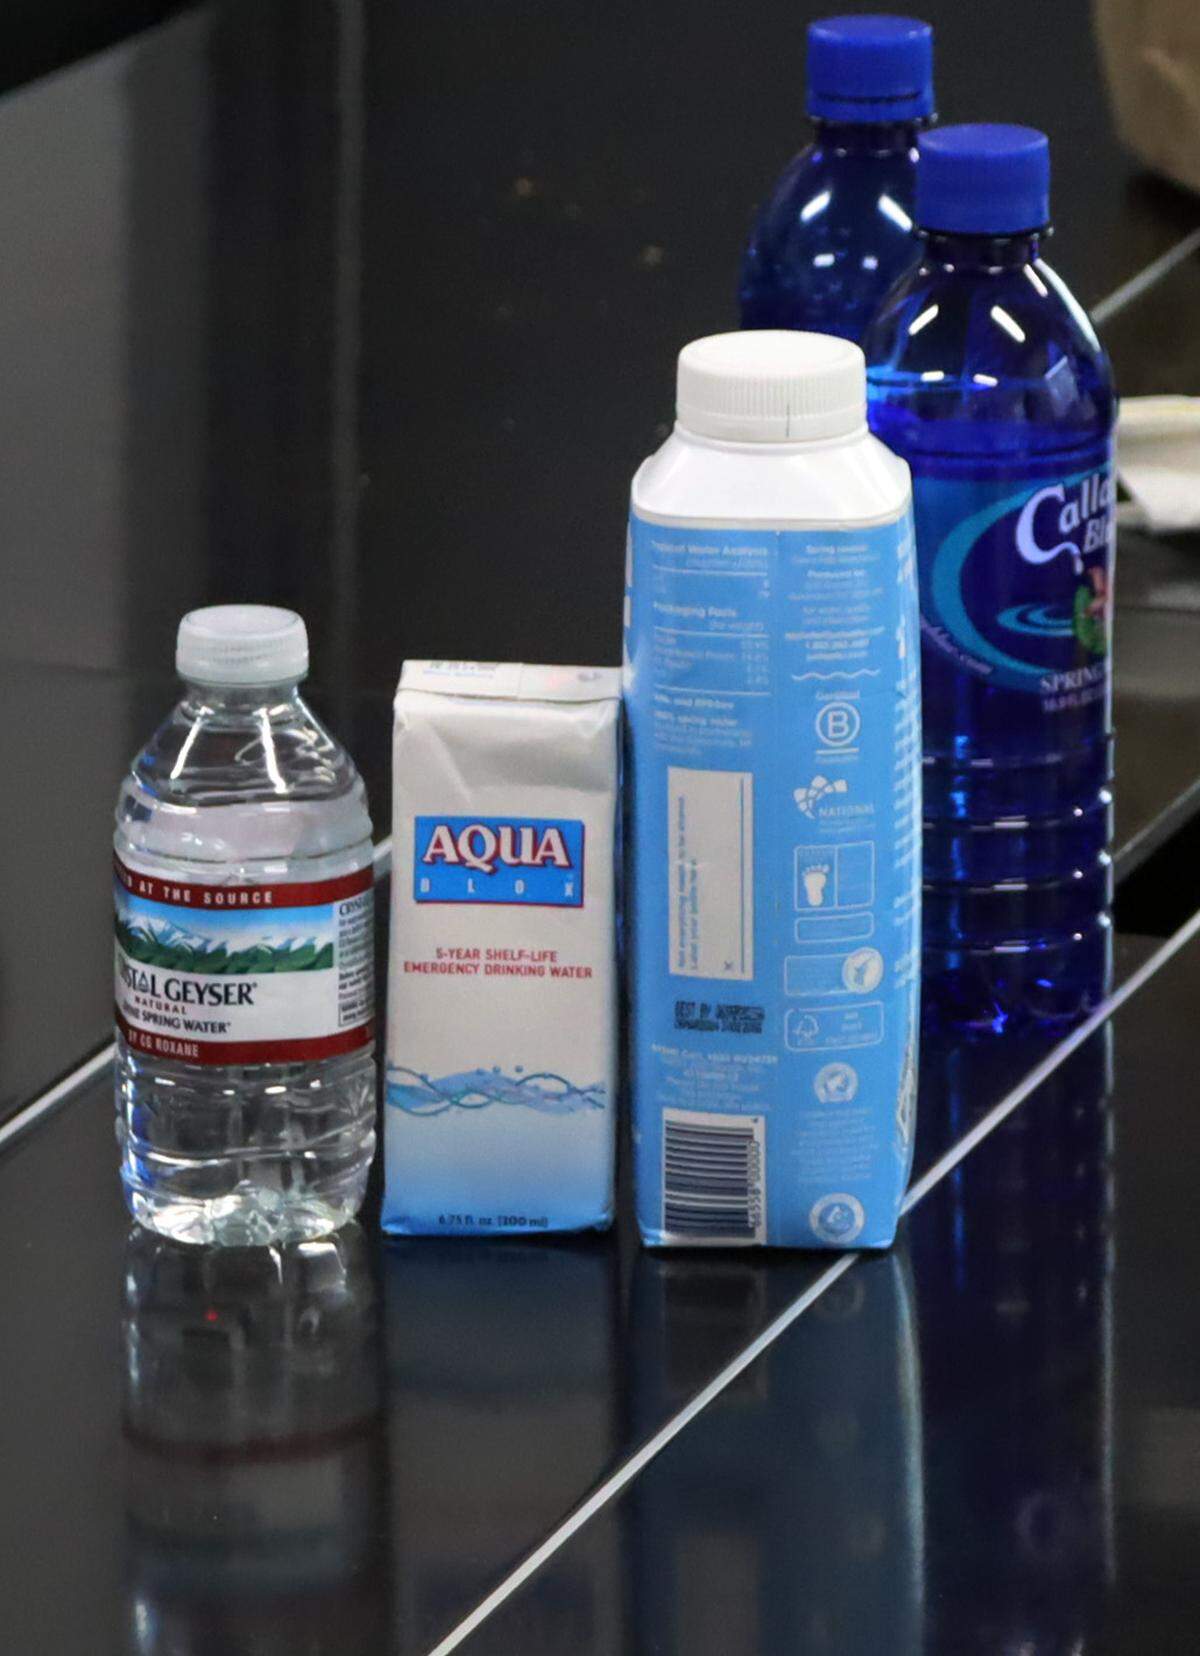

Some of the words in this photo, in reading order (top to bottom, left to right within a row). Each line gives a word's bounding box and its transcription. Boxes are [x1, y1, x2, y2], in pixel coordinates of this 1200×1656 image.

[1016, 474, 1115, 576] Calla
[1041, 664, 1107, 693] SPRIN
[827, 709, 850, 738] B
[422, 823, 573, 875] AQUA
[141, 880, 154, 895] AT
[163, 885, 192, 903] THE
[203, 891, 273, 905] SOURCE
[435, 947, 481, 961] 5-YEAR
[485, 948, 559, 963] SHELF-LIFE
[403, 960, 480, 975] EMERGENCY
[484, 964, 546, 977] DRINKING
[550, 965, 593, 979] WATER
[134, 994, 187, 1015] NATURAL
[142, 1009, 180, 1030] SPRING
[155, 1037, 200, 1058] ROXANE
